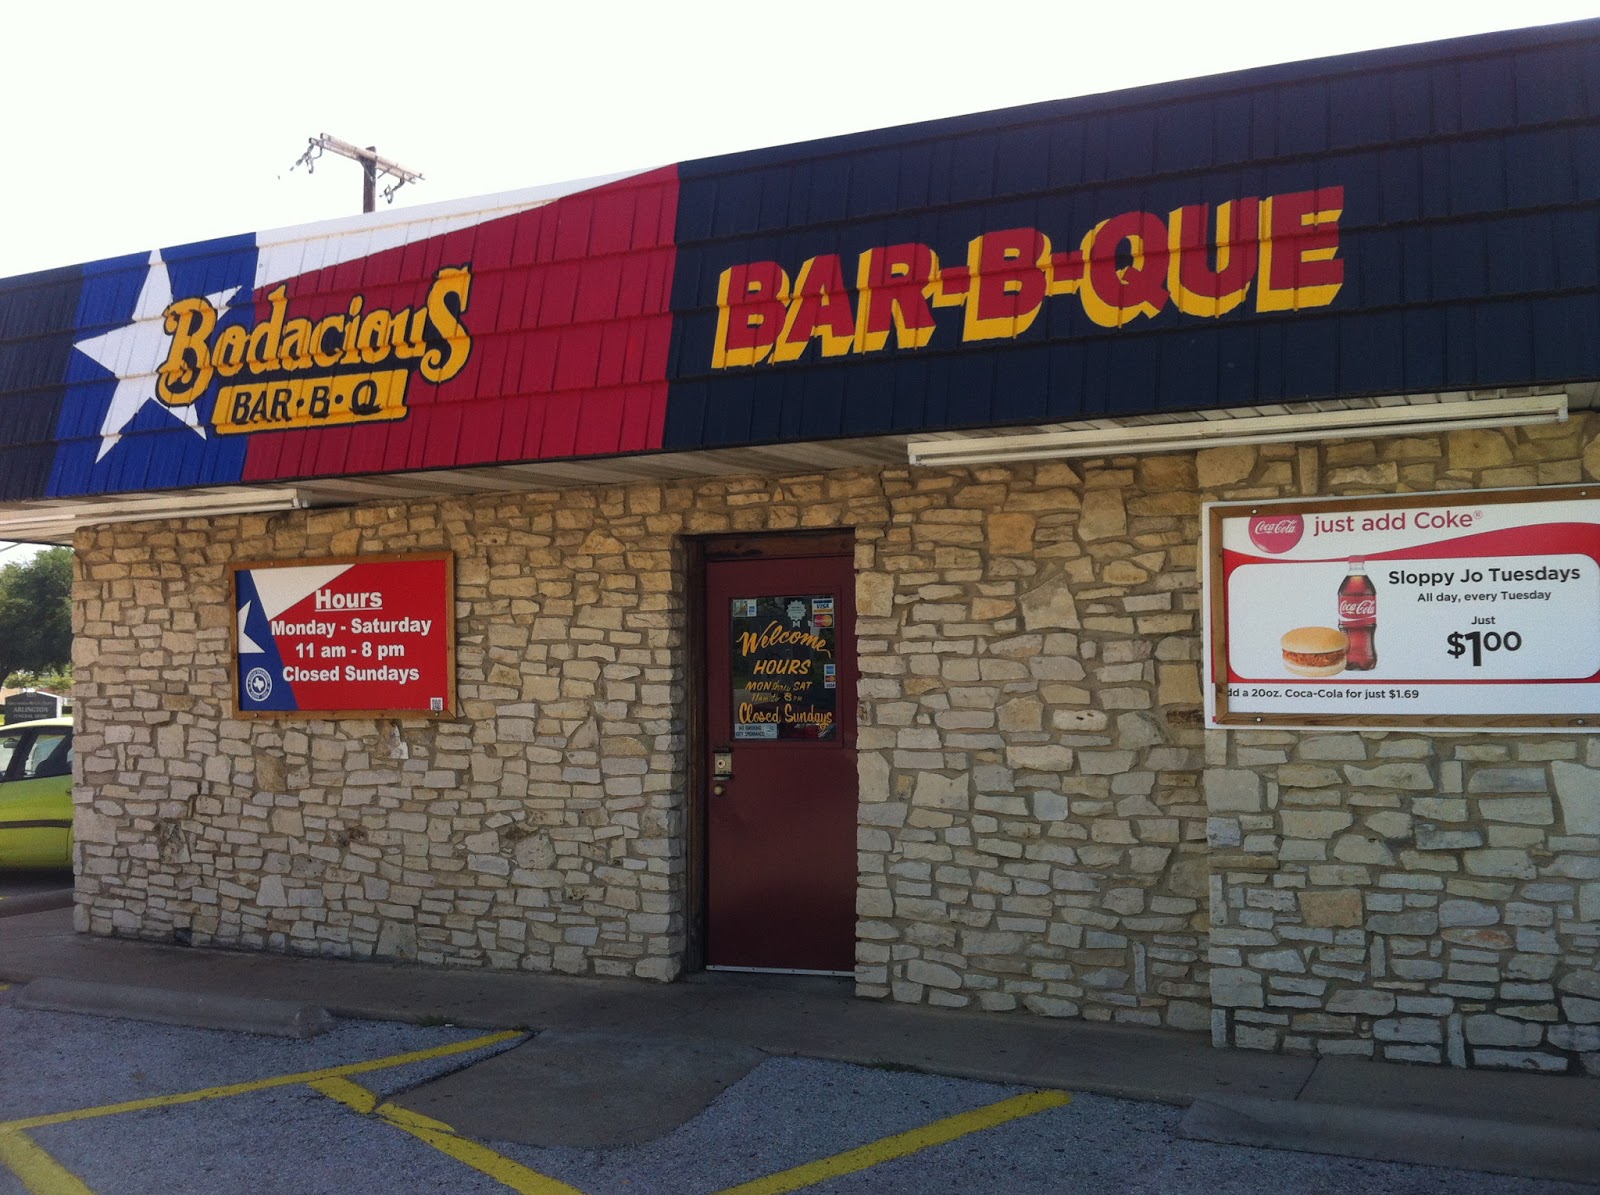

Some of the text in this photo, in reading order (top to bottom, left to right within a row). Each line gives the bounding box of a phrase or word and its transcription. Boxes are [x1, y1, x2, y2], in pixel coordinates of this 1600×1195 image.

[711, 186, 1344, 370] BAR-B-QUE
[1313, 516, 1354, 537] just
[1362, 512, 1406, 532] add
[1388, 566, 1581, 586] Sloppy Jo Tuesdays
[315, 588, 383, 611] Hours
[1417, 590, 1551, 604] All day, every Tuesday
[271, 619, 336, 638] Monday
[351, 616, 432, 636] Saturday
[1471, 615, 1496, 625] Just
[736, 620, 832, 658] Welcome
[295, 642, 315, 658] 11
[320, 645, 346, 658] am
[361, 641, 372, 658] 8
[377, 643, 405, 660] pm
[282, 665, 340, 682] Closed
[345, 665, 420, 684] Sundays
[753, 659, 811, 675] HOURS
[745, 681, 772, 691] MON
[793, 681, 813, 690] SAT
[1227, 687, 1240, 697] dd
[1251, 688, 1282, 698] 20oz.
[1285, 688, 1343, 698] Coca-Cola
[1345, 688, 1361, 698] for
[1364, 688, 1386, 699] just
[1389, 688, 1419, 699] $1.69
[739, 702, 833, 730] Closed Sundays
